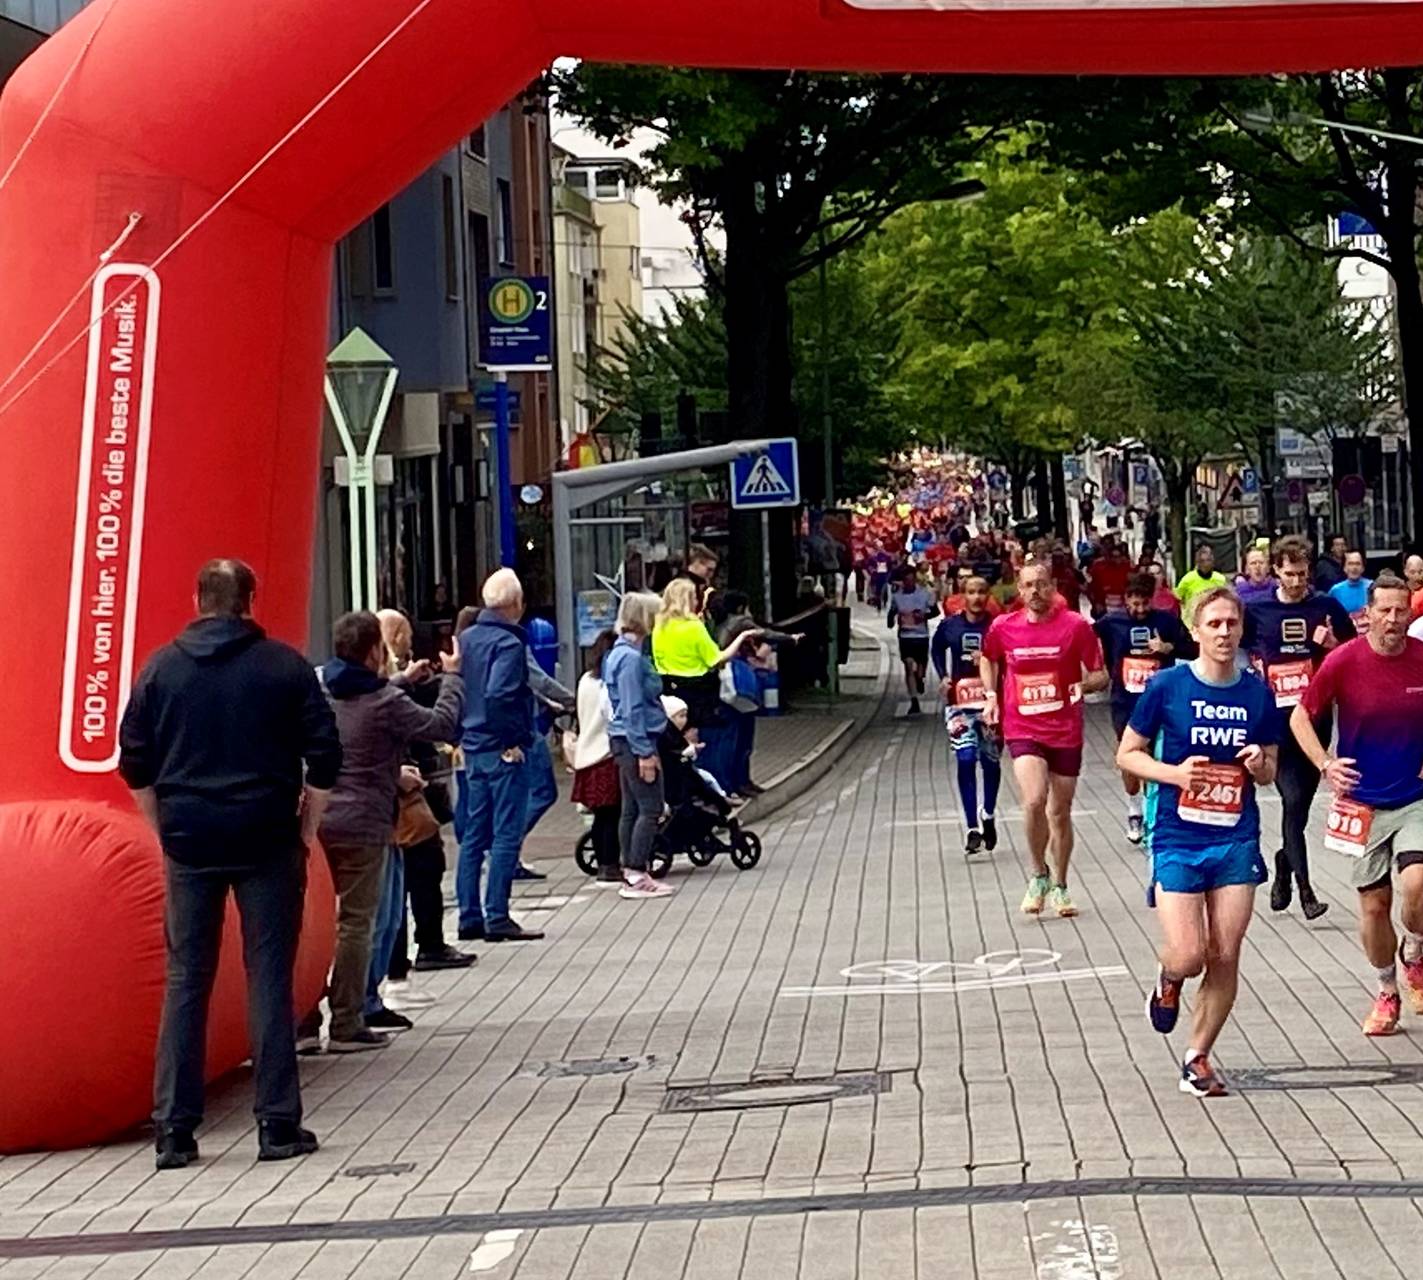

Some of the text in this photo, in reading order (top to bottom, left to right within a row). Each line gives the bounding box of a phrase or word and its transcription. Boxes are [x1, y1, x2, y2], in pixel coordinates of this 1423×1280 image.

[535, 291, 547, 310] 2
[110, 293, 137, 373] Musik.
[104, 377, 131, 445] beste
[102, 450, 126, 485] die
[91, 566, 118, 617] hier.
[93, 621, 113, 664] von
[1191, 700, 1248, 721] Team
[1190, 726, 1248, 747] RWE
